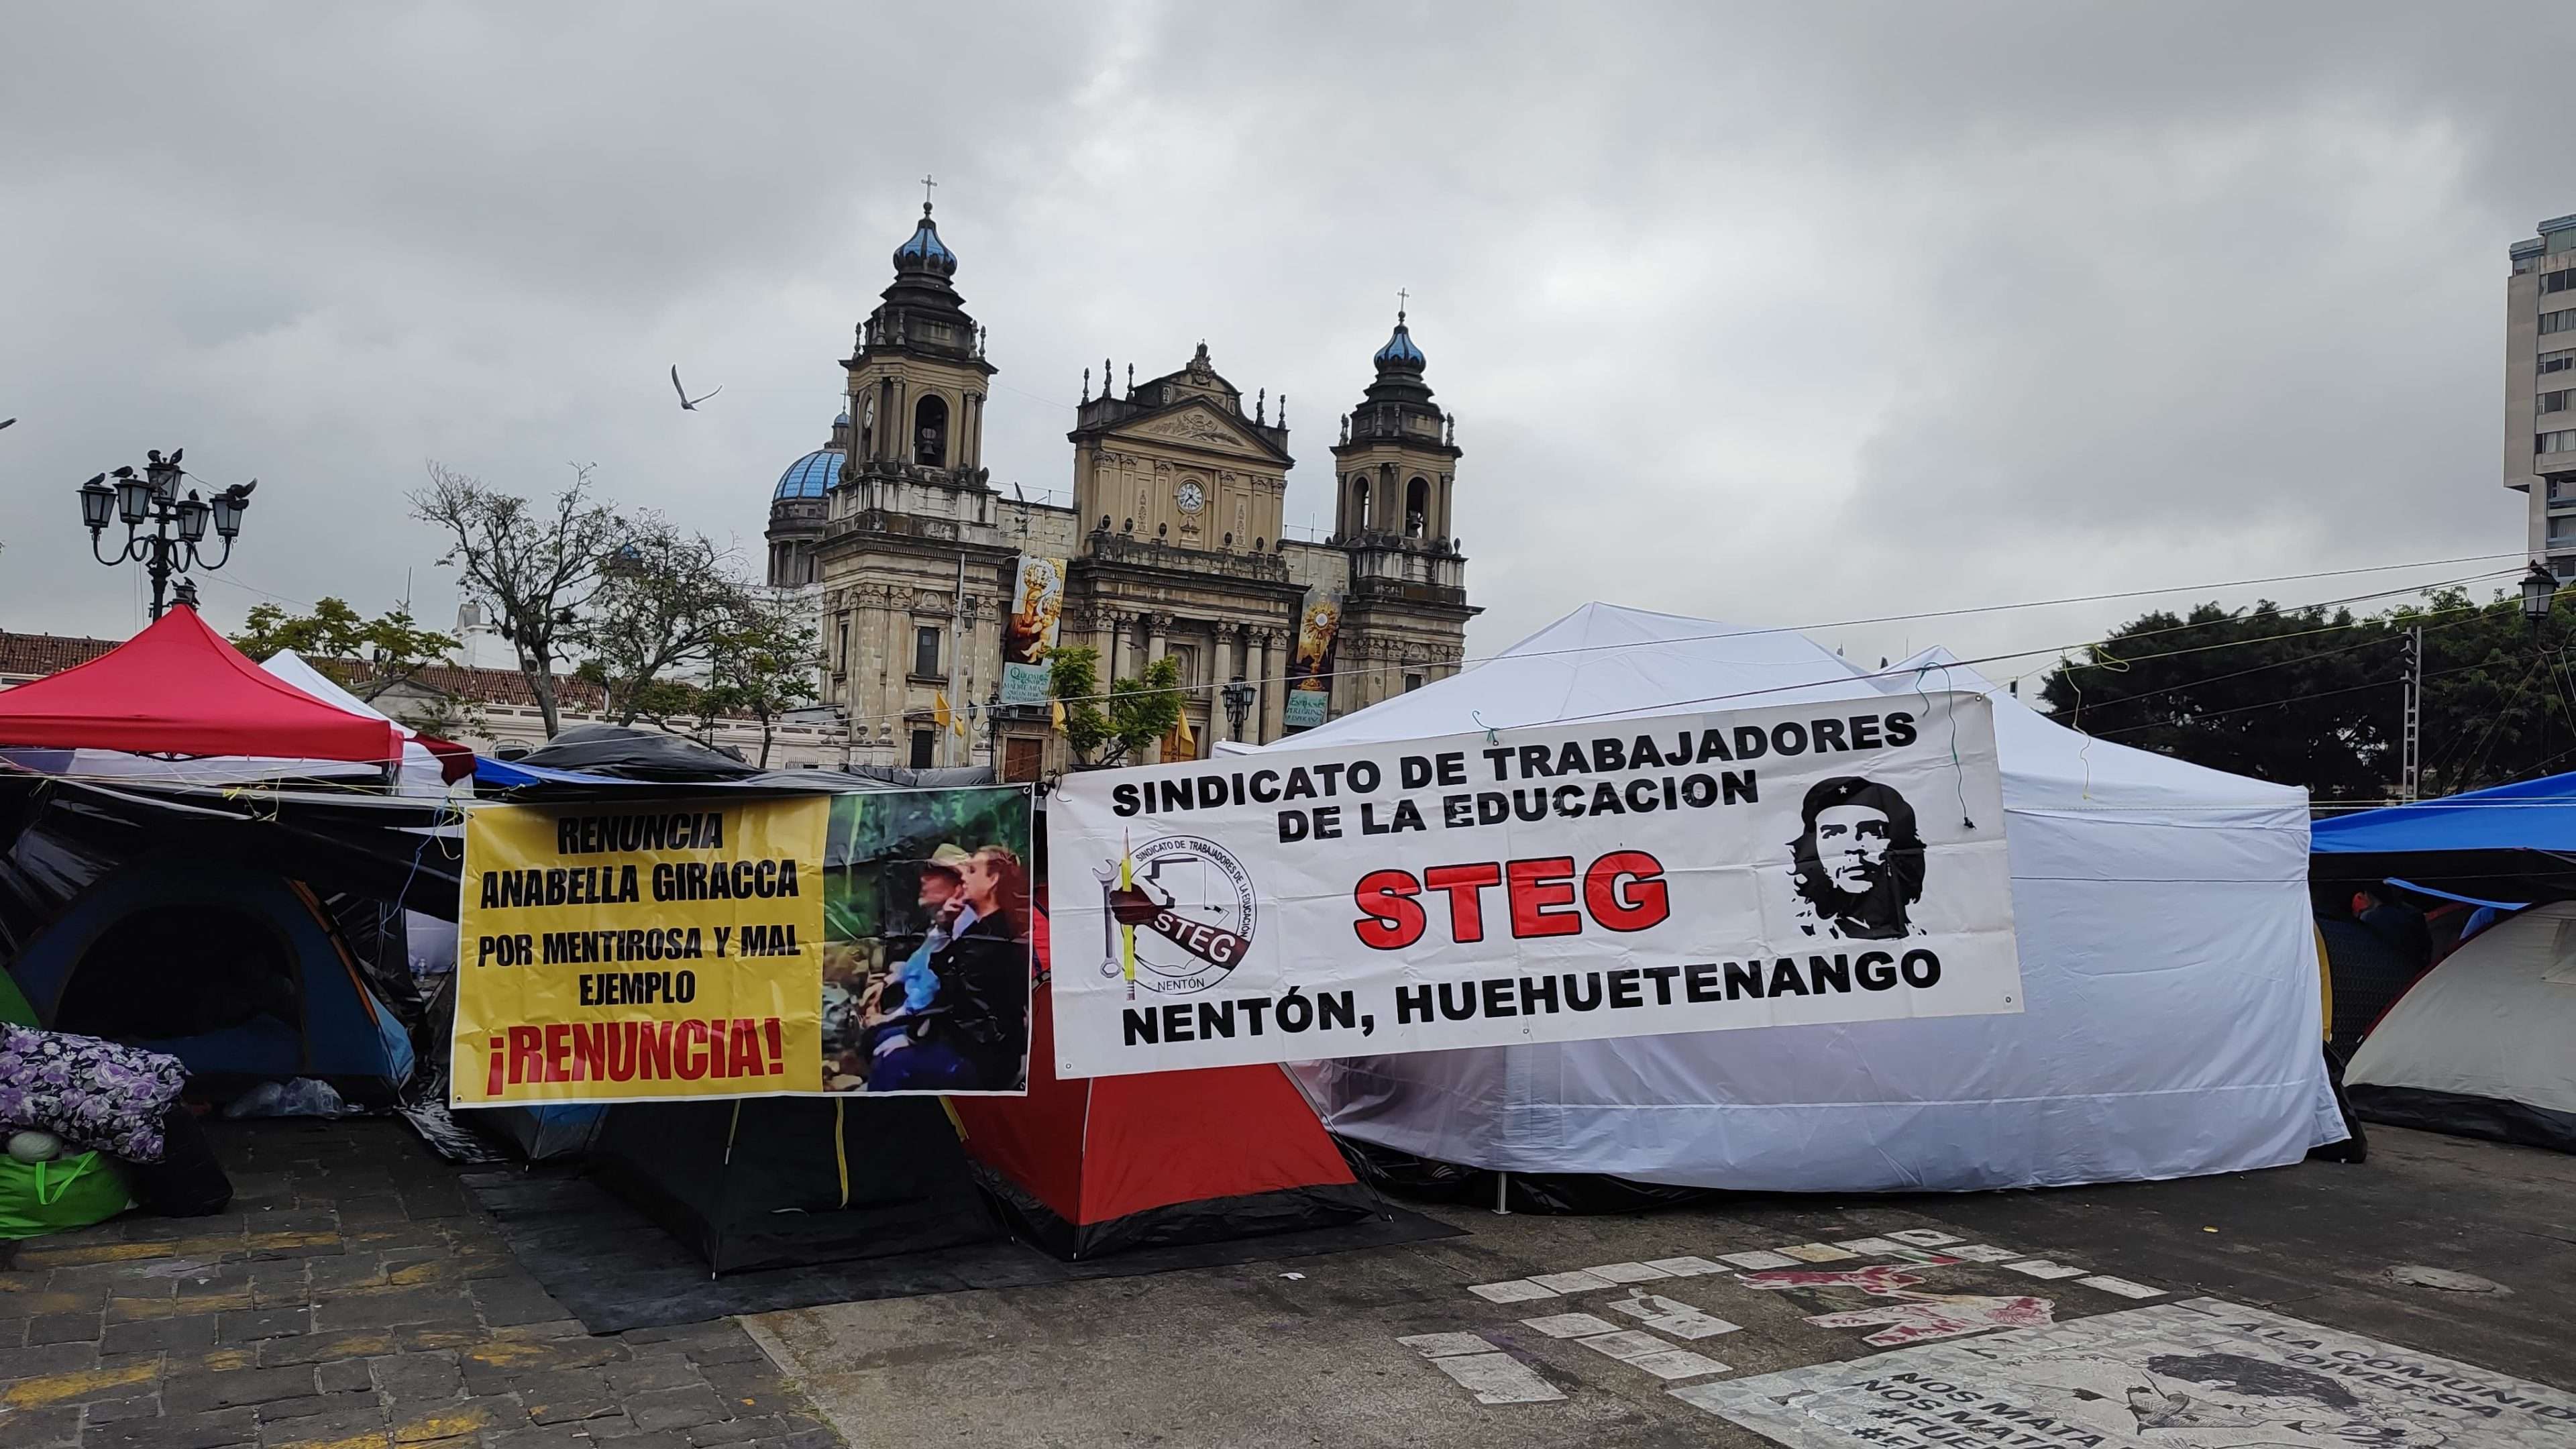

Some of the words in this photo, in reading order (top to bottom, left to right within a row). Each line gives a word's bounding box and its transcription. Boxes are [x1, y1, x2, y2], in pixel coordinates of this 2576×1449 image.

[1112, 760, 1381, 817] SINDICATO
[1400, 751, 1467, 790] DE
[1483, 712, 1917, 782] TRABAJADORES
[1277, 806, 1342, 843] DE
[1360, 799, 1427, 835] LA
[1443, 769, 1759, 828] EDUCACION
[557, 812, 723, 855] RENUNCIA
[1135, 840, 1173, 862] SINDICATO
[1174, 840, 1186, 849] DE
[1189, 841, 1237, 874] TRABAJADORES
[1233, 871, 1244, 884] DE
[480, 865, 640, 909] ANABELLA
[652, 859, 799, 902] GIRACCA
[1239, 883, 1249, 894] LA
[1353, 850, 1670, 951] STEG
[1240, 892, 1252, 938] EDUCACIÓN
[478, 934, 533, 967] POR
[542, 927, 703, 965] MENTIROSA
[713, 926, 732, 958] Y
[741, 924, 801, 957] MAL
[1154, 913, 1236, 963] STEG
[579, 971, 696, 1006] EJEMPLO
[1122, 985, 1375, 1046] NENTÓN,
[1395, 949, 1941, 1024] HUEHUETENANGO
[1157, 976, 1205, 993] NENTÓN
[487, 1018, 784, 1095] ¡RENUNCIA!
[1851, 1379, 1945, 1411] NOS
[1889, 1372, 1984, 1403] NOS
[2285, 1352, 2503, 1418] DIVERSA
[2331, 1350, 2576, 1423] COMUNID
[1867, 1408, 2001, 1449] #FUE
